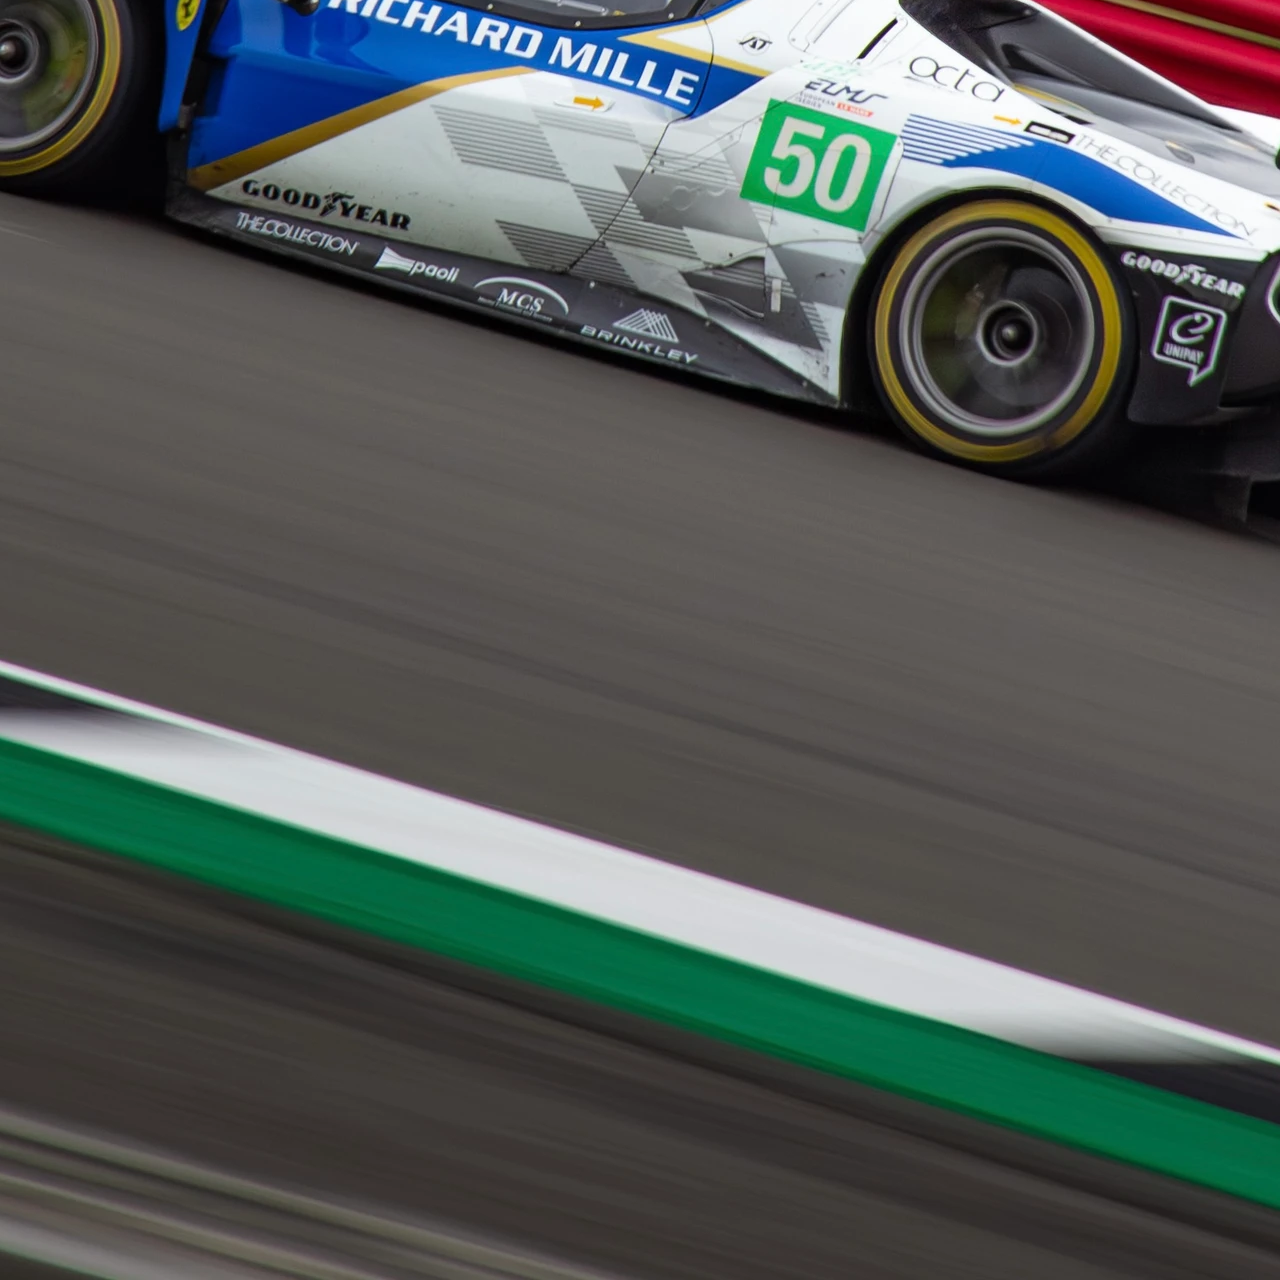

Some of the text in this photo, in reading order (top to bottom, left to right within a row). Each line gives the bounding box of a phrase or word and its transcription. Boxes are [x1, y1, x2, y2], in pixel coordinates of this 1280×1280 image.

[548, 36, 700, 106] MILLE
[909, 56, 1005, 103] octa
[763, 114, 871, 213] 50
[242, 179, 412, 231] GOODYEAR
[409, 260, 461, 283] paoli
[1121, 251, 1246, 300] GOODYEAR
[497, 287, 545, 313] MCS
[581, 324, 699, 365] BRINKLEY
[1163, 341, 1205, 365] UNIPAY
